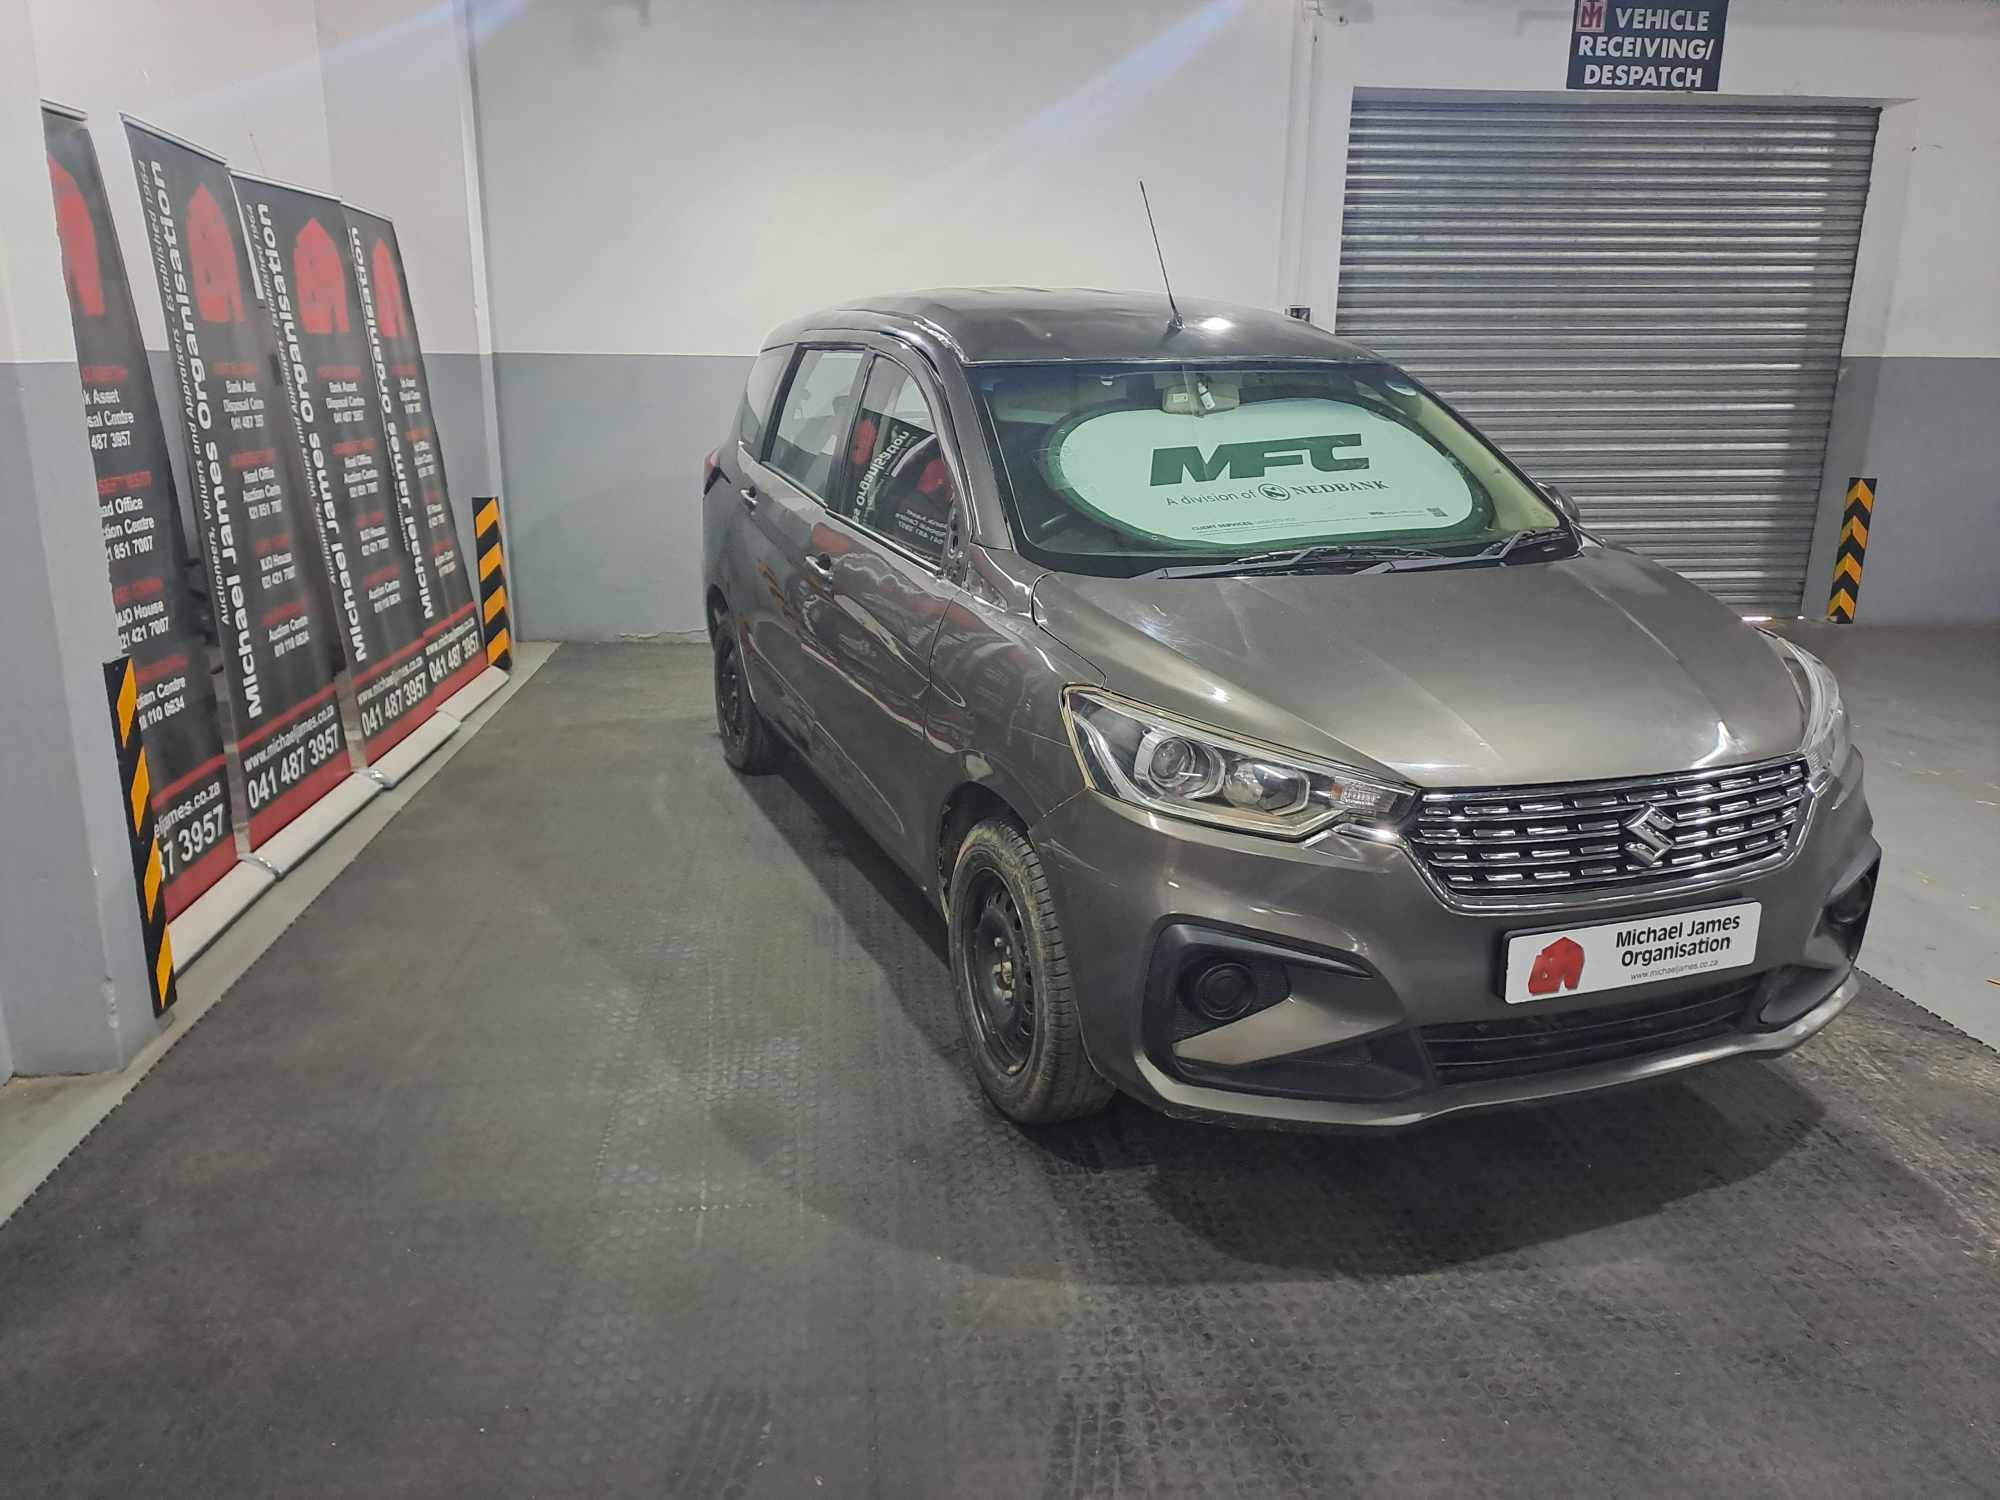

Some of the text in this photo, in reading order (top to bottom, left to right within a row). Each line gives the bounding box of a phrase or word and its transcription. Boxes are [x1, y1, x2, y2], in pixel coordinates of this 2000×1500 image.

[1615, 7, 1710, 32] VEHICLE
[1578, 35, 1715, 61] RECEIVING/
[1583, 64, 1703, 88] DESPATCH
[147, 208, 175, 312] Established
[351, 227, 392, 414] Organisation
[172, 327, 195, 419] Appraisers
[91, 432, 107, 450] 487
[151, 160, 263, 719] Michael James Organisation
[188, 421, 201, 455] and
[257, 203, 367, 662] Michael James Organisation
[387, 421, 412, 509] James
[1150, 433, 1370, 487] MFC
[115, 496, 143, 514] Office
[1180, 491, 1239, 506] division
[1240, 489, 1257, 499] of
[1290, 480, 1390, 496] NEDBANK
[114, 541, 131, 559] 851
[132, 535, 153, 554] 7007
[124, 517, 155, 534] Centre
[208, 526, 230, 625] Auctioneers,
[404, 516, 434, 619] Michael
[134, 601, 164, 620] House
[132, 625, 148, 643] 421
[429, 630, 479, 683] 041 487 3957
[361, 672, 427, 737] 041 487 3957
[243, 704, 334, 773] www.michaeljames.co.za
[248, 722, 338, 809] 041 487 3957
[178, 803, 224, 862] 3957
[1615, 915, 1741, 948] Michael James
[1621, 936, 1731, 967] Organisation
[1630, 960, 1719, 981] www.michaeljames.co.za
